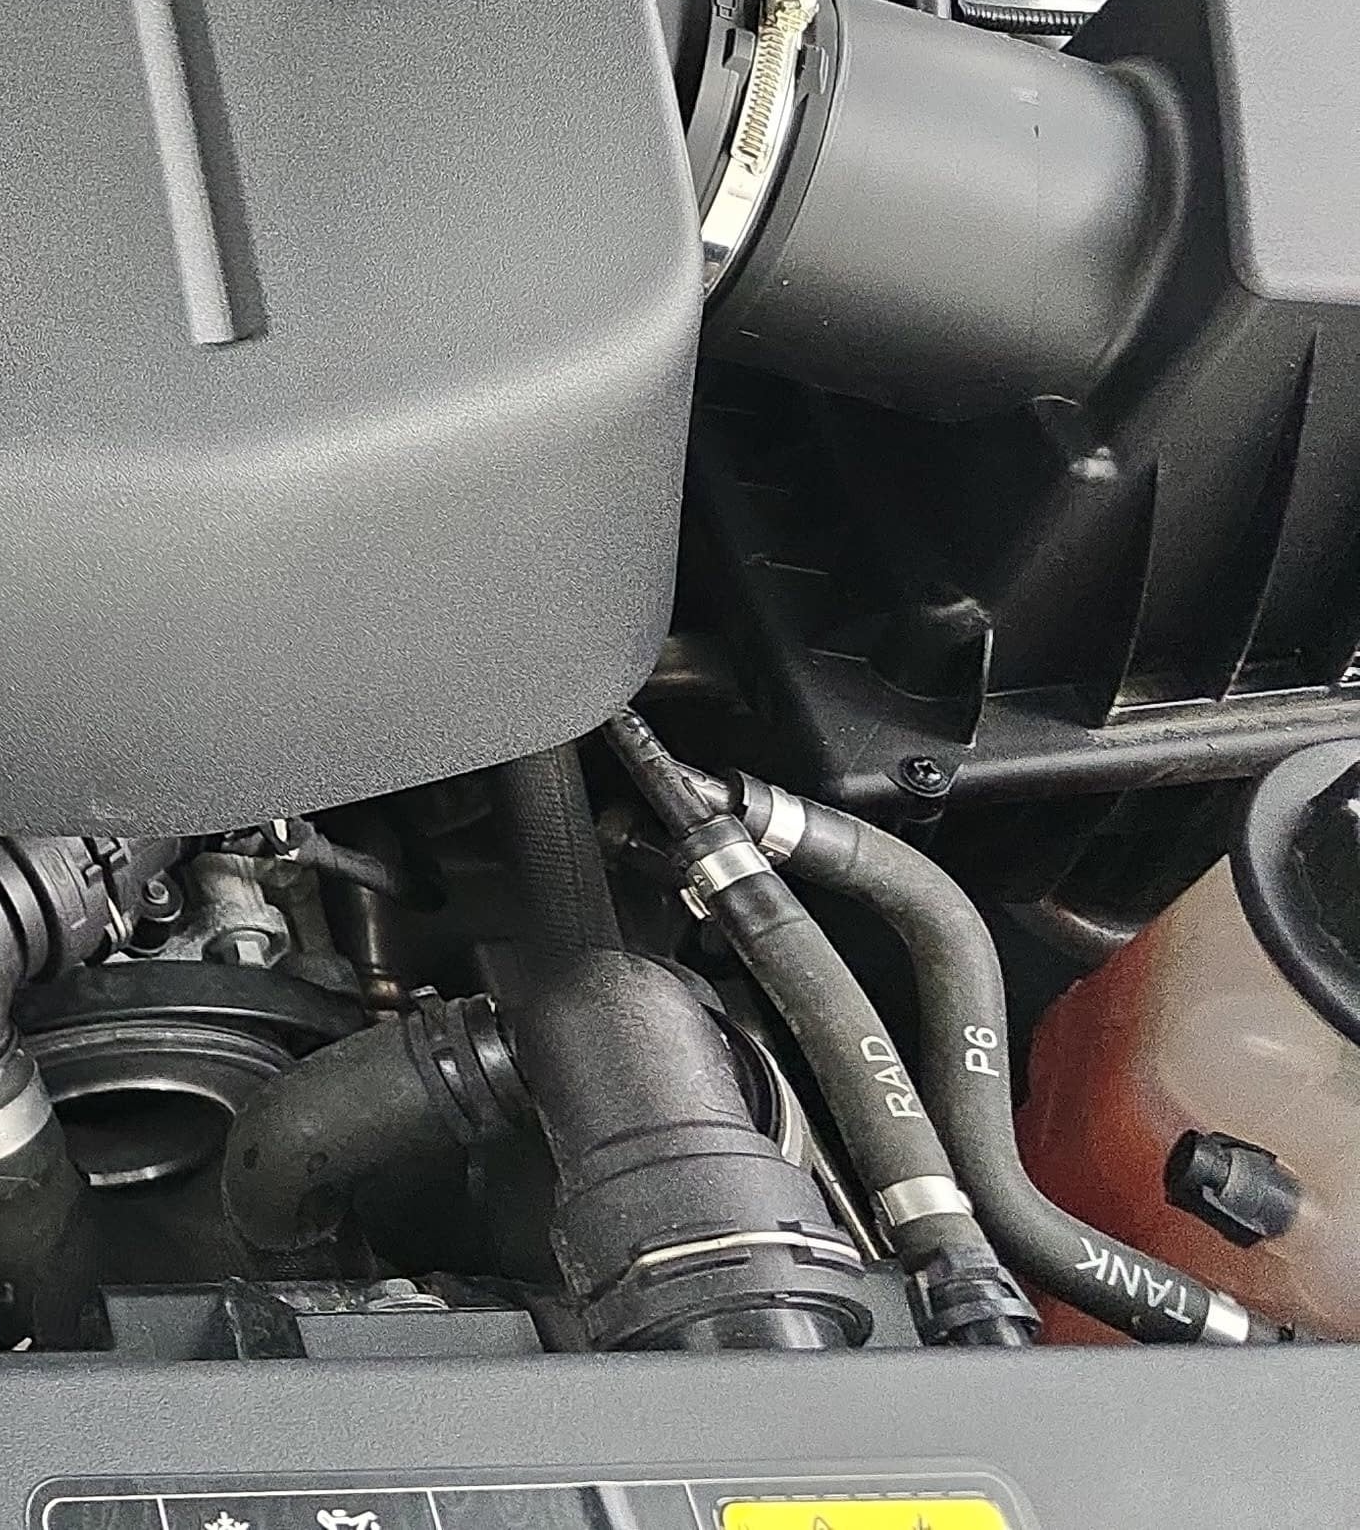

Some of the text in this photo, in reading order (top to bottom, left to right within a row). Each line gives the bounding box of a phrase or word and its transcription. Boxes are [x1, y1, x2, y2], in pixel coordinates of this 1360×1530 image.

[860, 1035, 925, 1119] RAD
[963, 1025, 1000, 1078] P6
[1074, 1236, 1193, 1325] TANK
